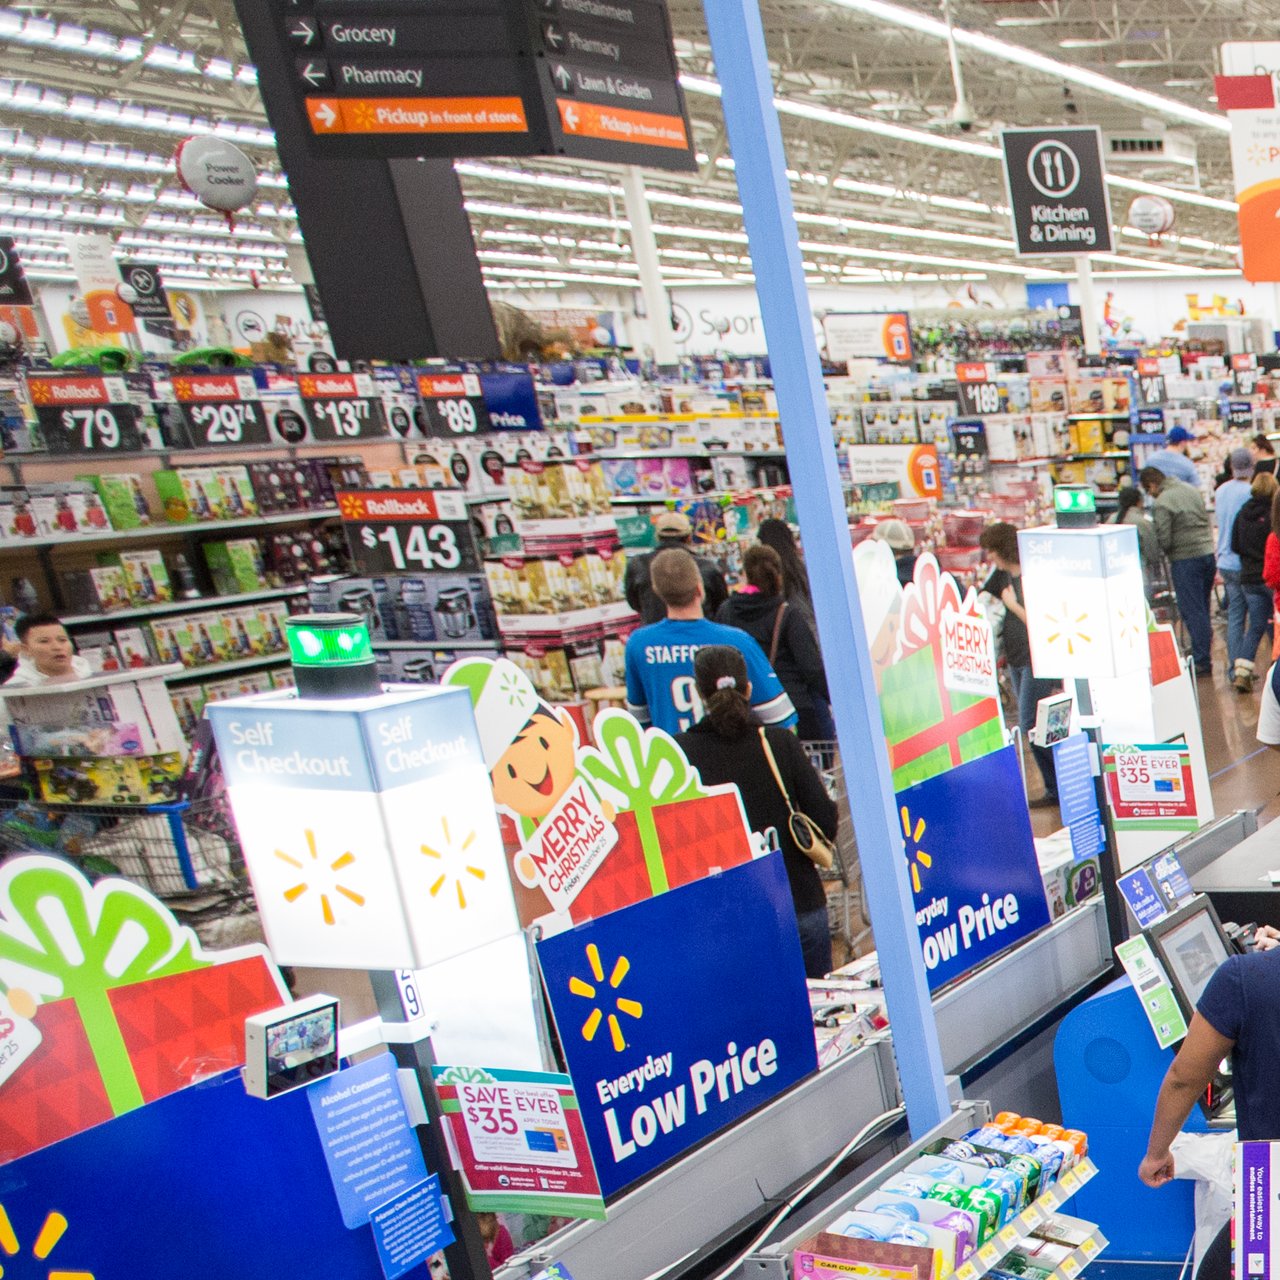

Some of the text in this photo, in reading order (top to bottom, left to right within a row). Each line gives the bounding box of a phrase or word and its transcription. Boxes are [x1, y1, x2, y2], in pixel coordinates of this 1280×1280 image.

[332, 24, 396, 46] Grocery
[568, 34, 620, 62] Pharmacy
[341, 65, 424, 88] Pharmacy
[577, 73, 653, 100] Lawn Garden
[377, 108, 429, 128] Pickup
[430, 113, 441, 124] in
[442, 111, 469, 124] front
[471, 111, 487, 124] of
[205, 162, 240, 176] Power
[207, 174, 245, 187] Cooker
[1031, 203, 1089, 223] Kitchen
[1030, 225, 1096, 246] & Dining
[52, 384, 101, 400] Rollback
[193, 381, 235, 398] Rollback
[316, 380, 356, 396] Rollback
[438, 400, 477, 433] $89
[62, 409, 120, 449] $79
[367, 499, 430, 516] Rollback
[362, 525, 462, 569] $143
[1028, 541, 1053, 554] Self
[945, 621, 990, 656] MERRY
[946, 652, 993, 677] CHRISTMAS
[671, 676, 705, 733] 9
[228, 721, 275, 746] Self
[379, 715, 414, 747] Self
[236, 750, 352, 777] Checkout
[385, 736, 470, 774] Checkout
[1119, 755, 1148, 766] SAVE
[1151, 759, 1178, 769] EVER
[1120, 768, 1150, 784] $35
[529, 785, 594, 869] MERRY
[548, 814, 606, 893] CHRISTMAS
[959, 892, 1020, 951] Price
[597, 1049, 673, 1105] Everyday
[463, 1086, 512, 1105] SAVE
[516, 1097, 560, 1114] EVER
[602, 1037, 779, 1165] Low Price
[467, 1107, 519, 1135] $35
[1257, 1167, 1265, 1184] Your
[1256, 1215, 1265, 1230] way
[820, 1262, 856, 1273] CAR CUP
